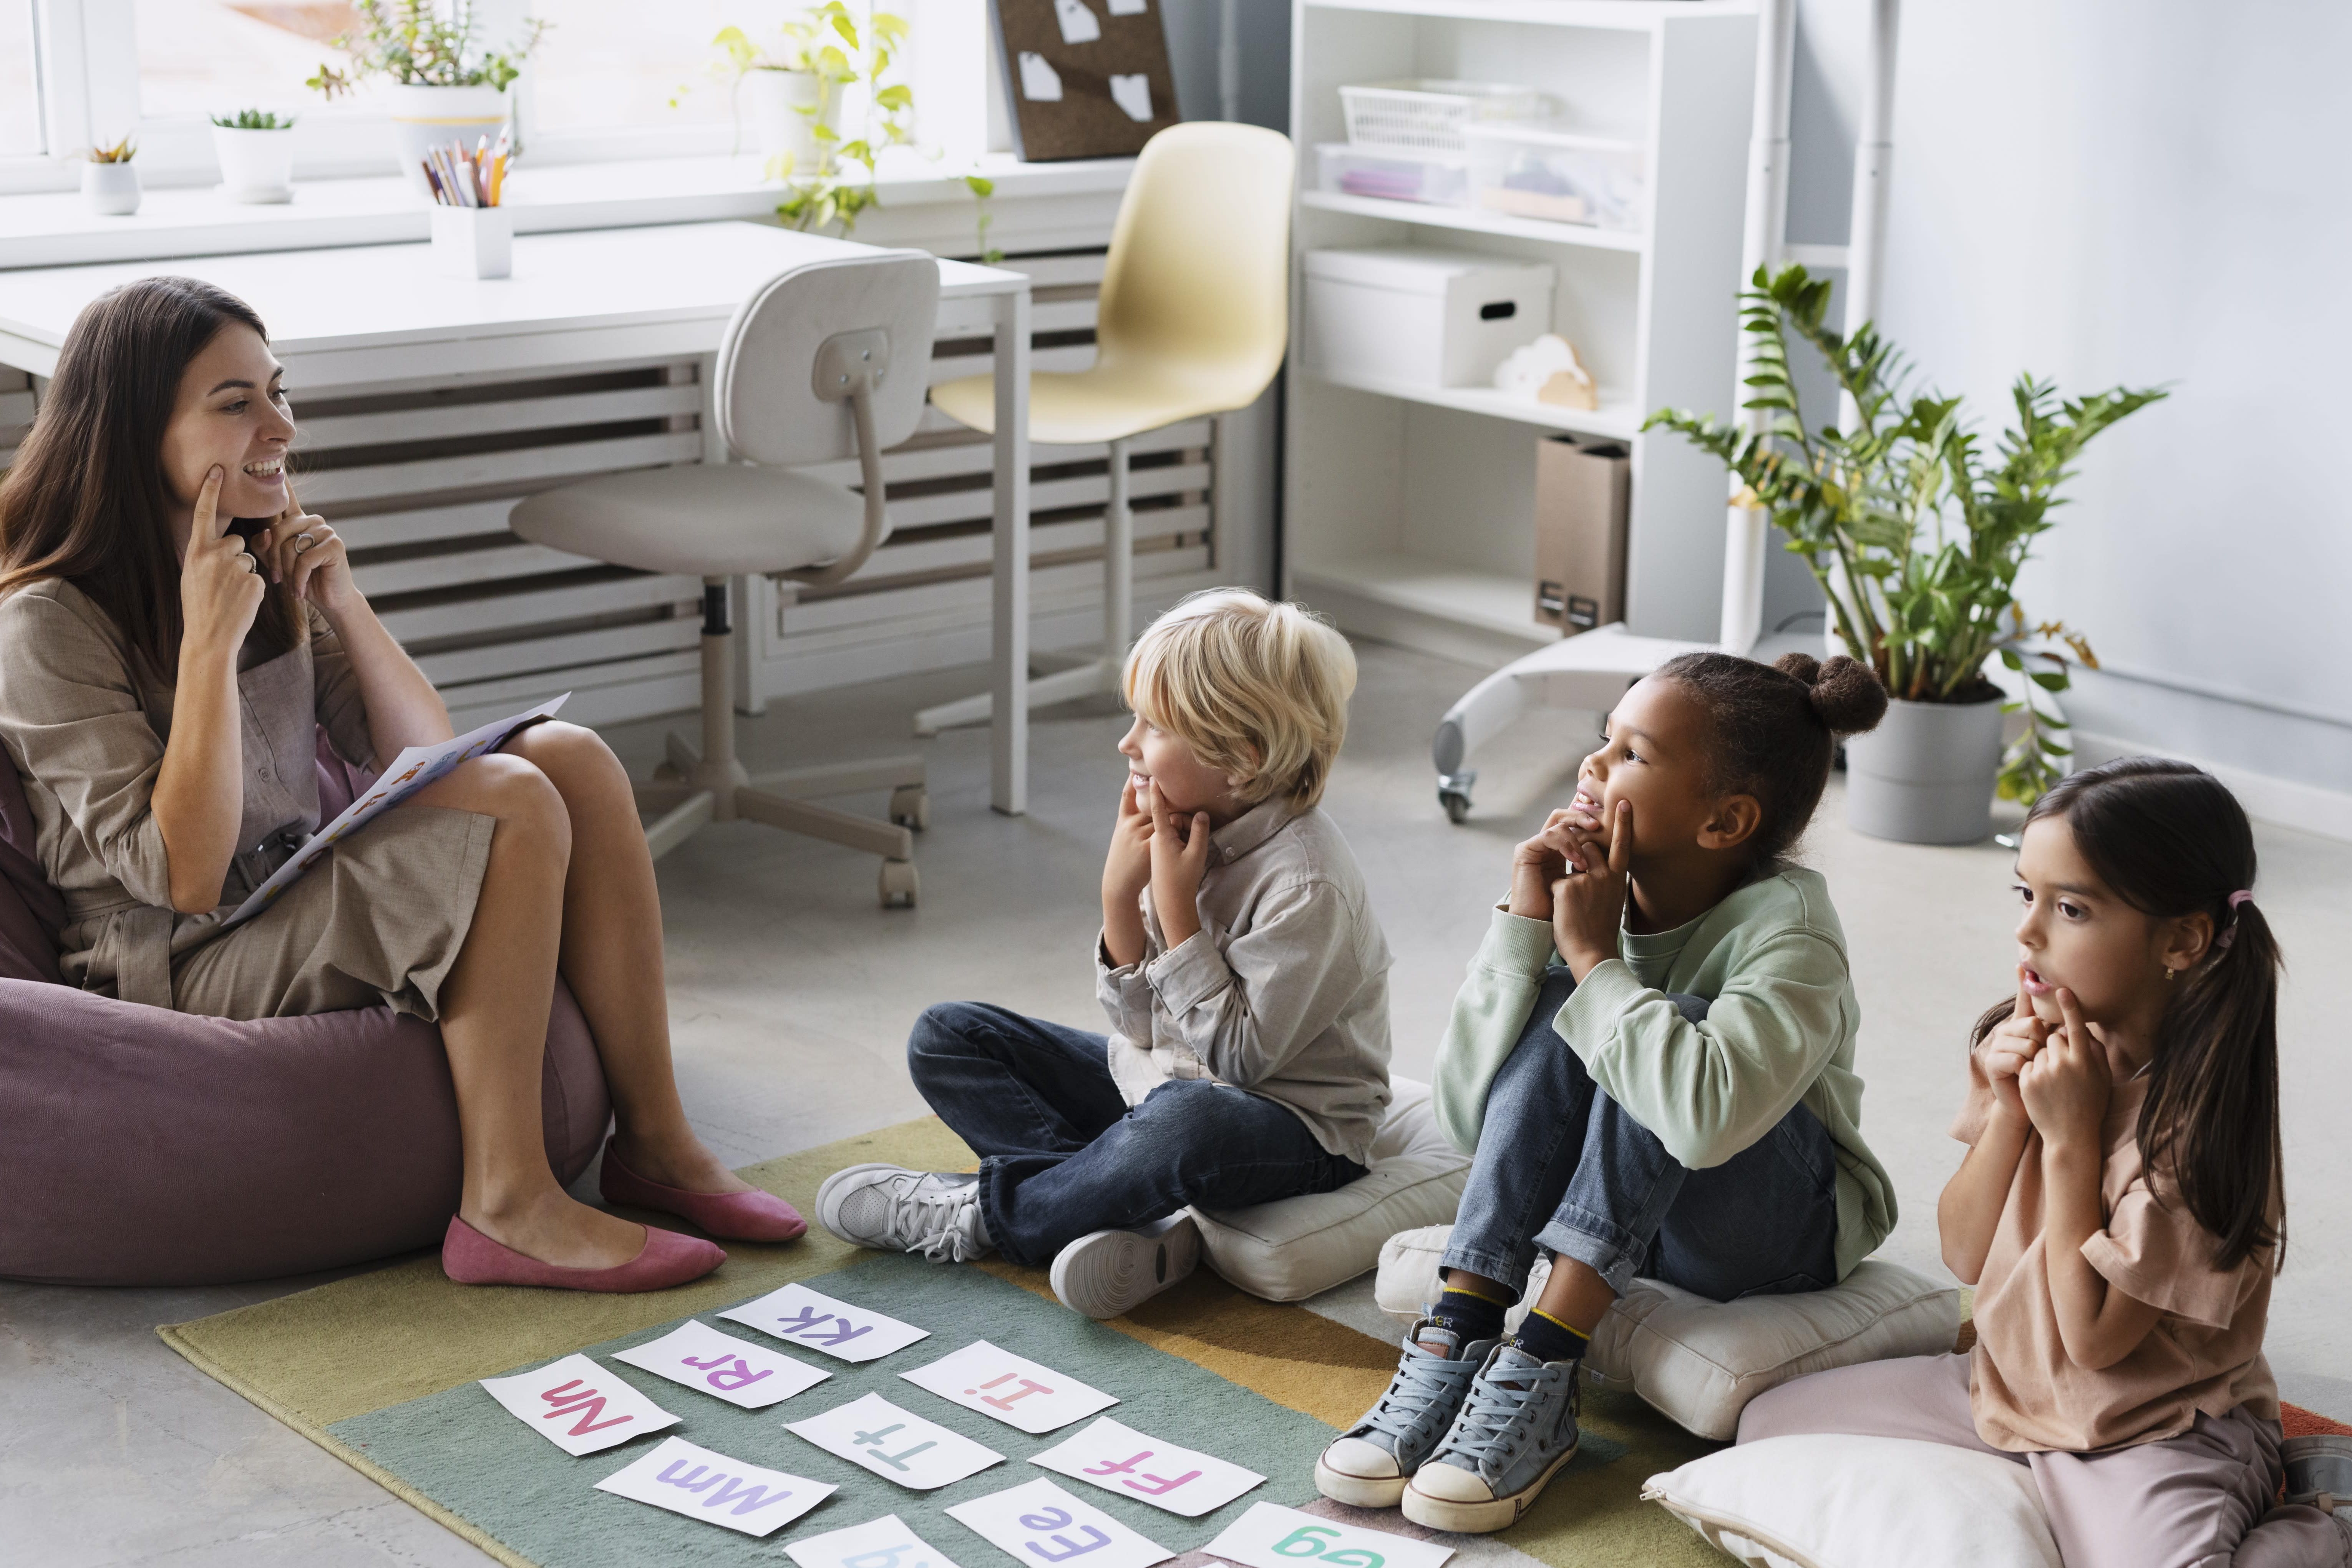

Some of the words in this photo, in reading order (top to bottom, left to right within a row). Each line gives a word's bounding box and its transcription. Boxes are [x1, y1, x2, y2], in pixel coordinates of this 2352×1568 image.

[391, 761, 426, 785] A
[777, 1306, 874, 1347] Kk
[680, 1354, 774, 1392] Rr
[964, 1373, 1054, 1411] Ii
[541, 1379, 634, 1437] Nn
[853, 1423, 938, 1472] Tt
[656, 1459, 793, 1515] Mm
[1082, 1450, 1203, 1496] Ff
[1018, 1507, 1112, 1563] Ee
